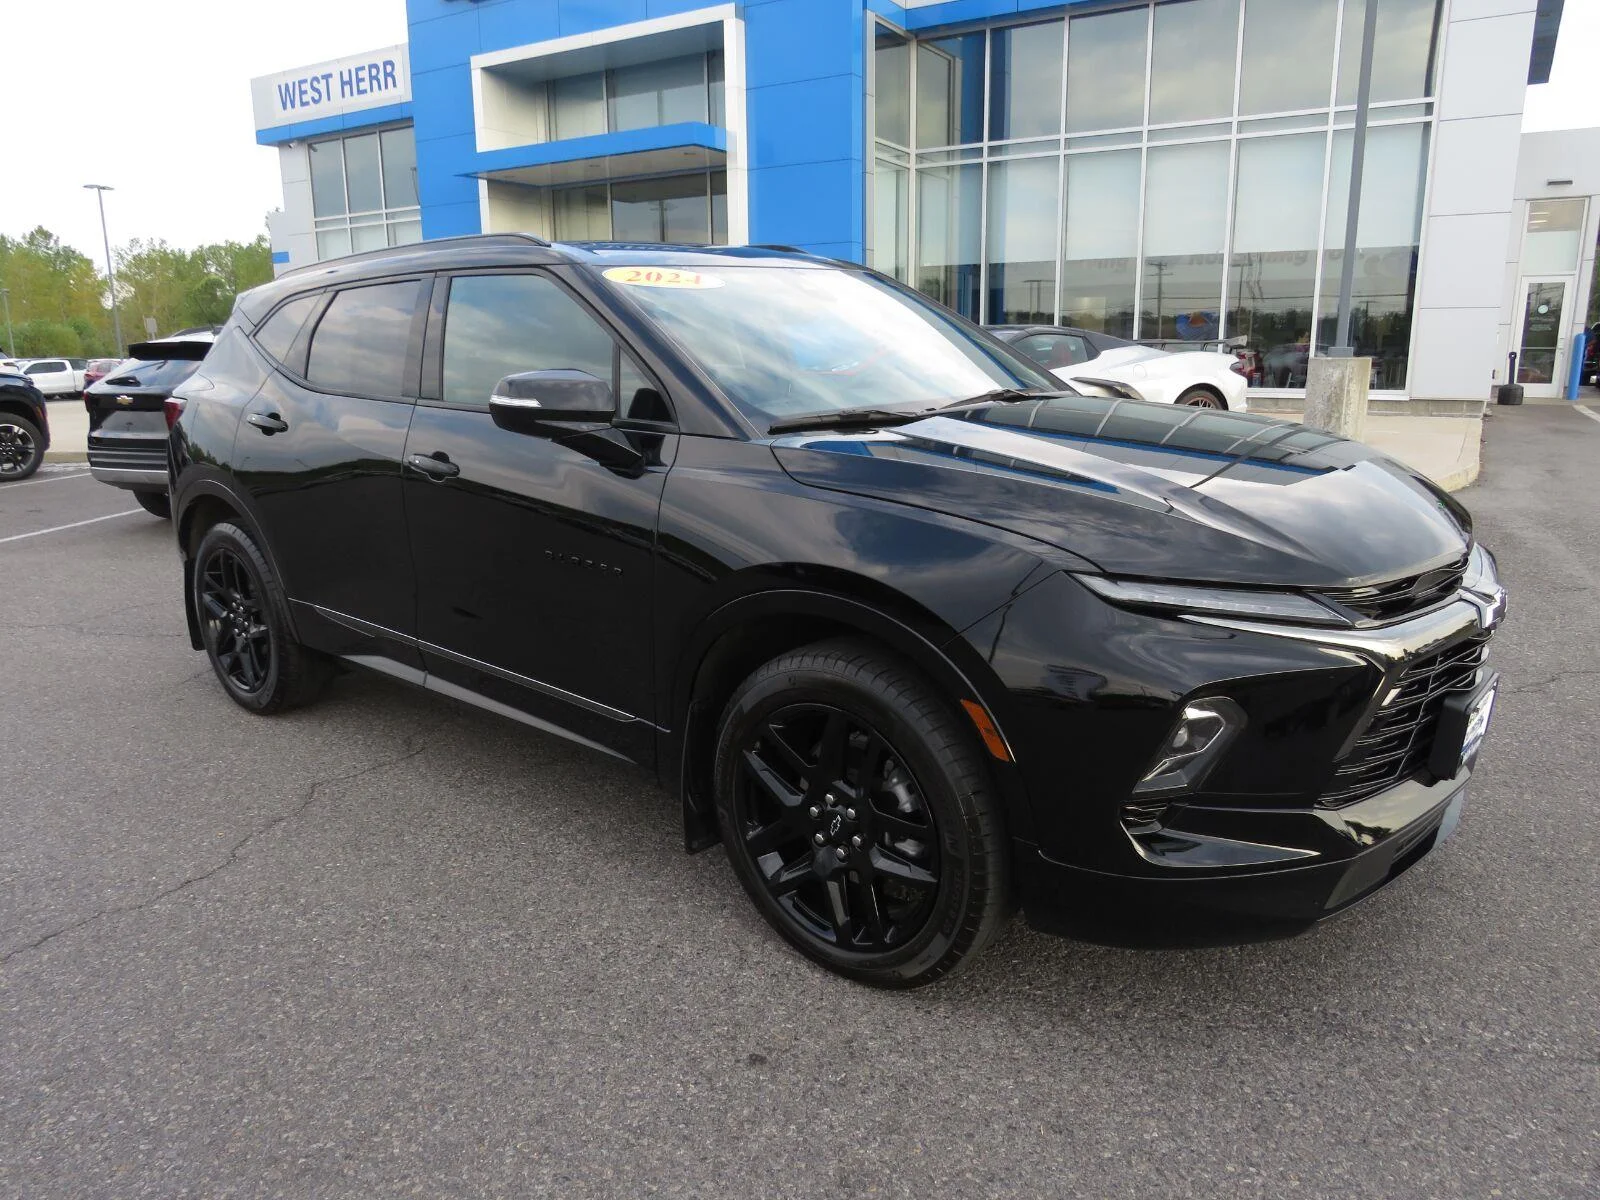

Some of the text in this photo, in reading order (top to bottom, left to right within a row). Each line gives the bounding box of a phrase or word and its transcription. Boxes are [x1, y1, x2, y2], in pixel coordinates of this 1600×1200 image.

[278, 60, 397, 110] WEST HERR
[626, 271, 700, 285] 2024
